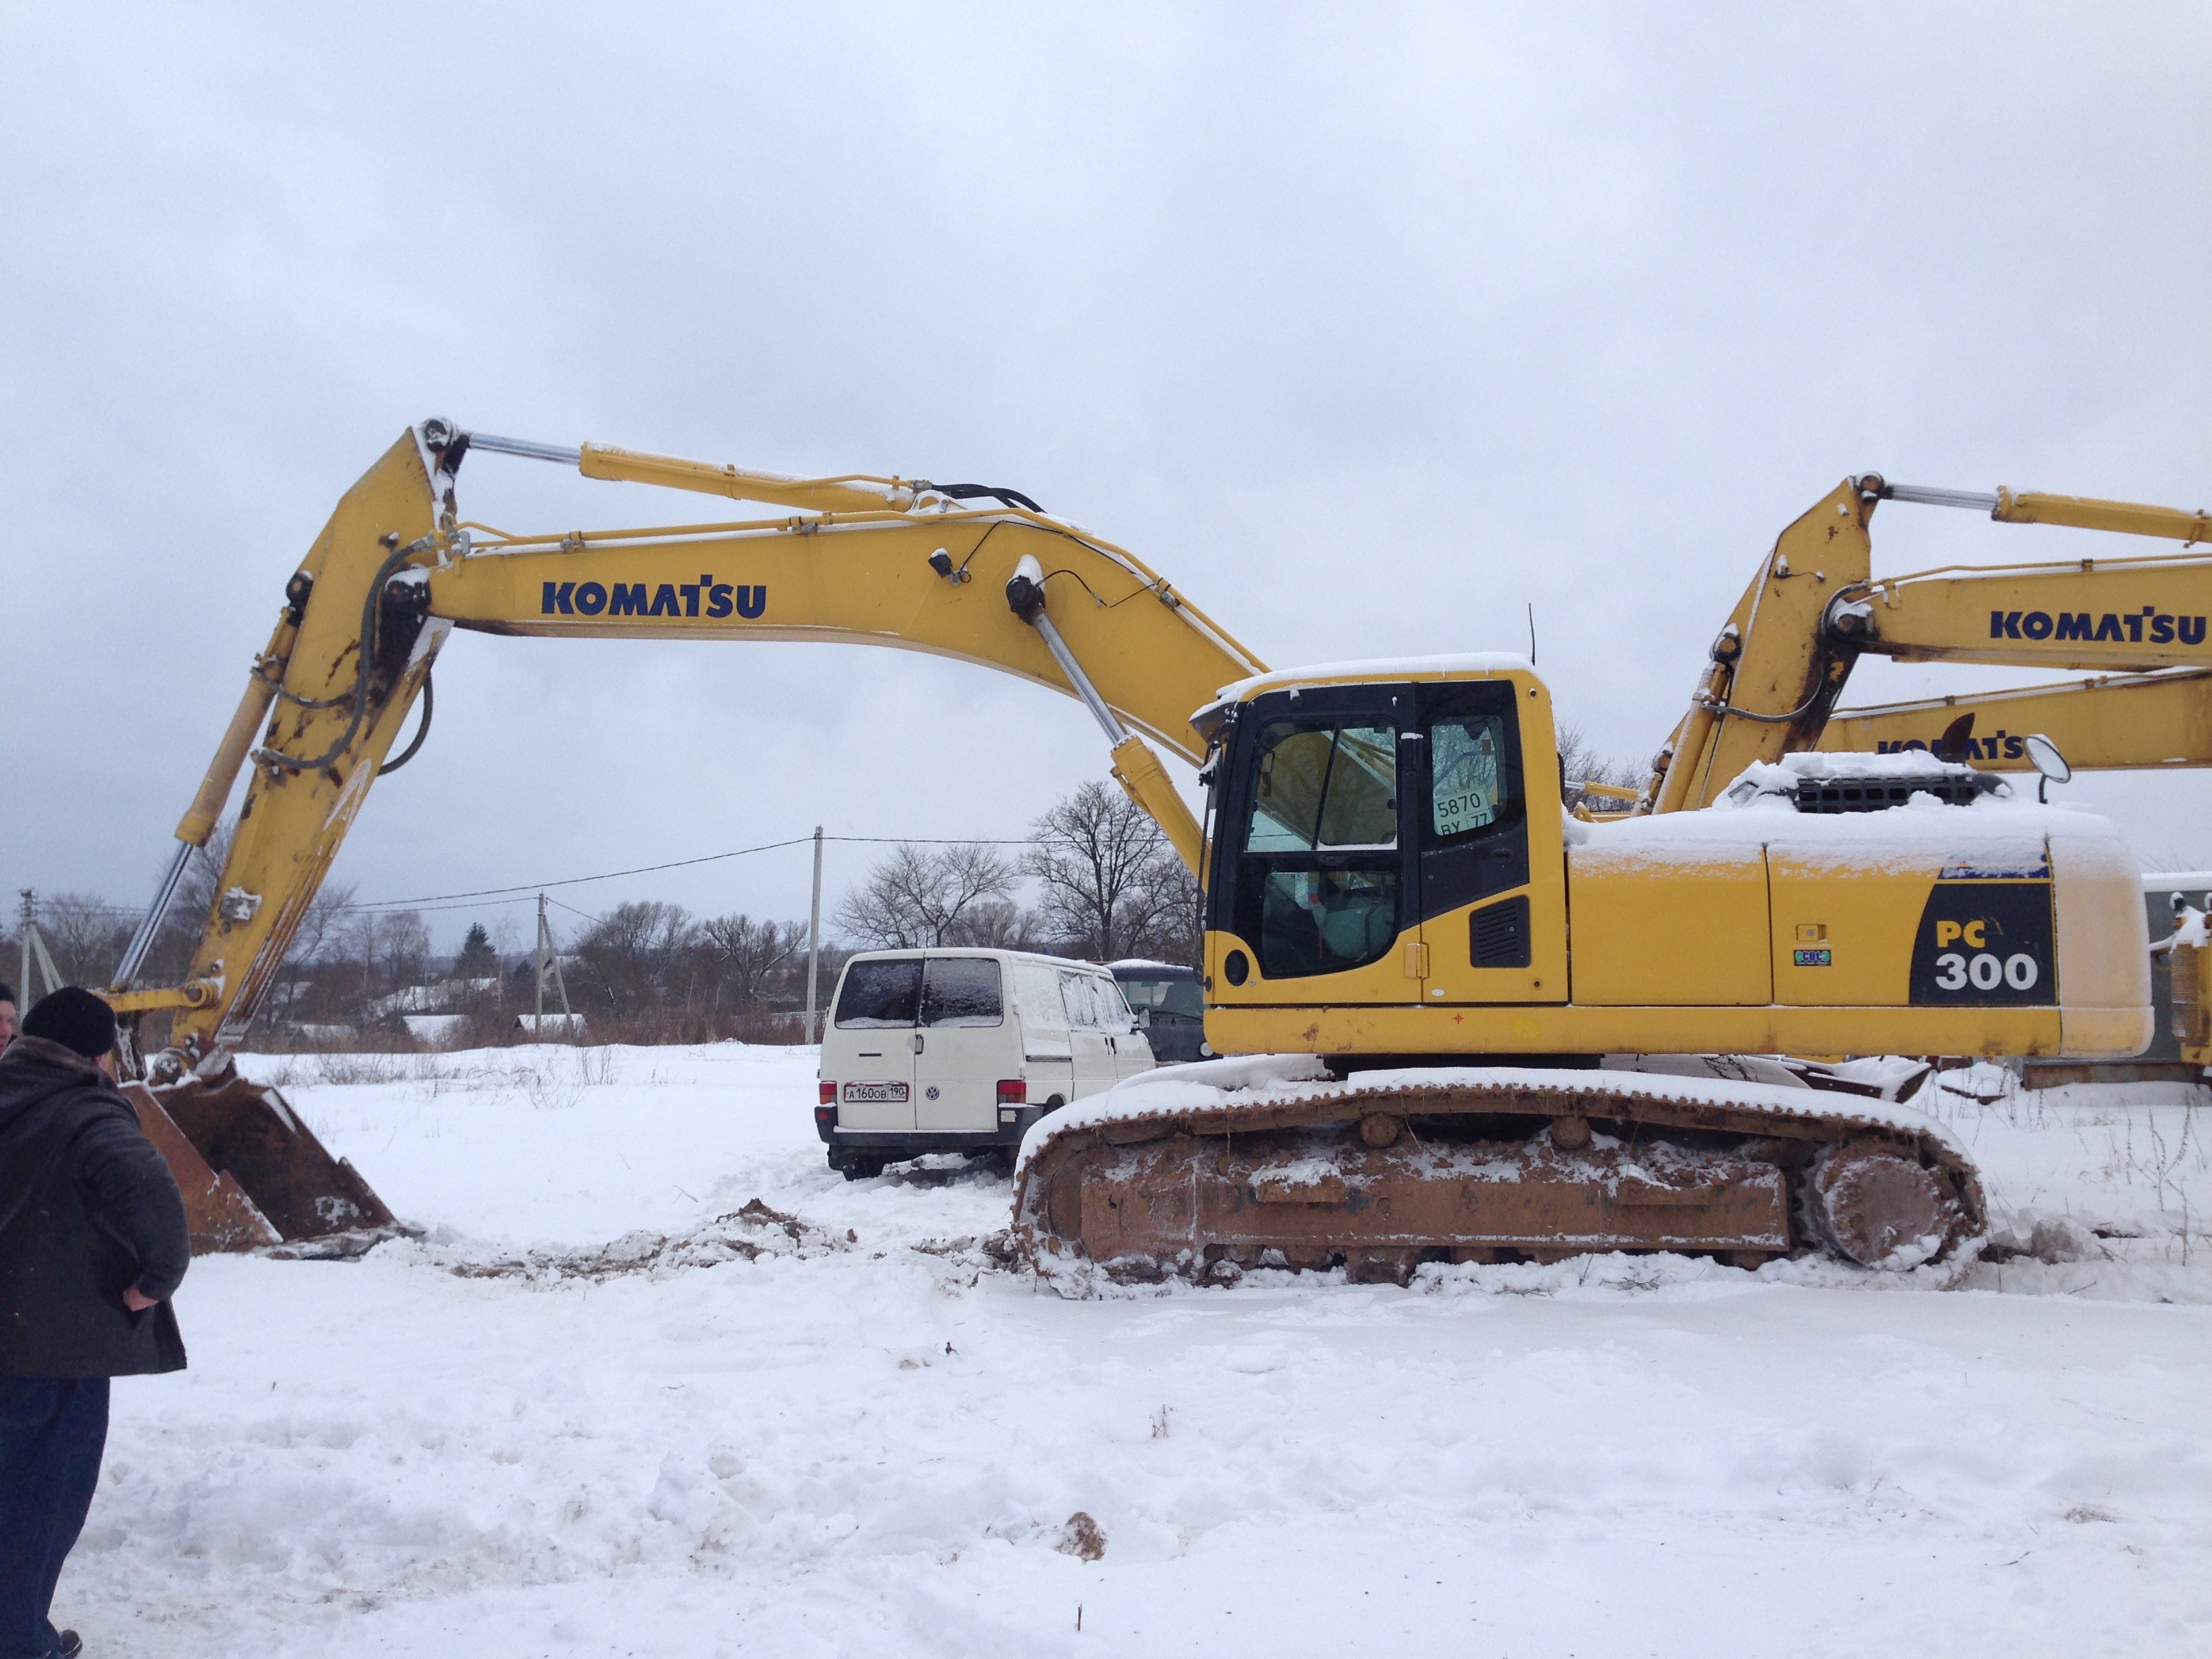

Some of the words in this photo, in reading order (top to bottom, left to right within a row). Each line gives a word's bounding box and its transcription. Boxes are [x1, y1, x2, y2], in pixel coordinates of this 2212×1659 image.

[541, 574, 766, 619] KOMATSU
[1990, 606, 2207, 645] KOMATSU
[1437, 793, 1481, 818] 5870
[1471, 813, 1487, 827] 77
[1936, 920, 1986, 947] PC
[1935, 953, 2039, 991] 300
[888, 1087, 904, 1096] 190
